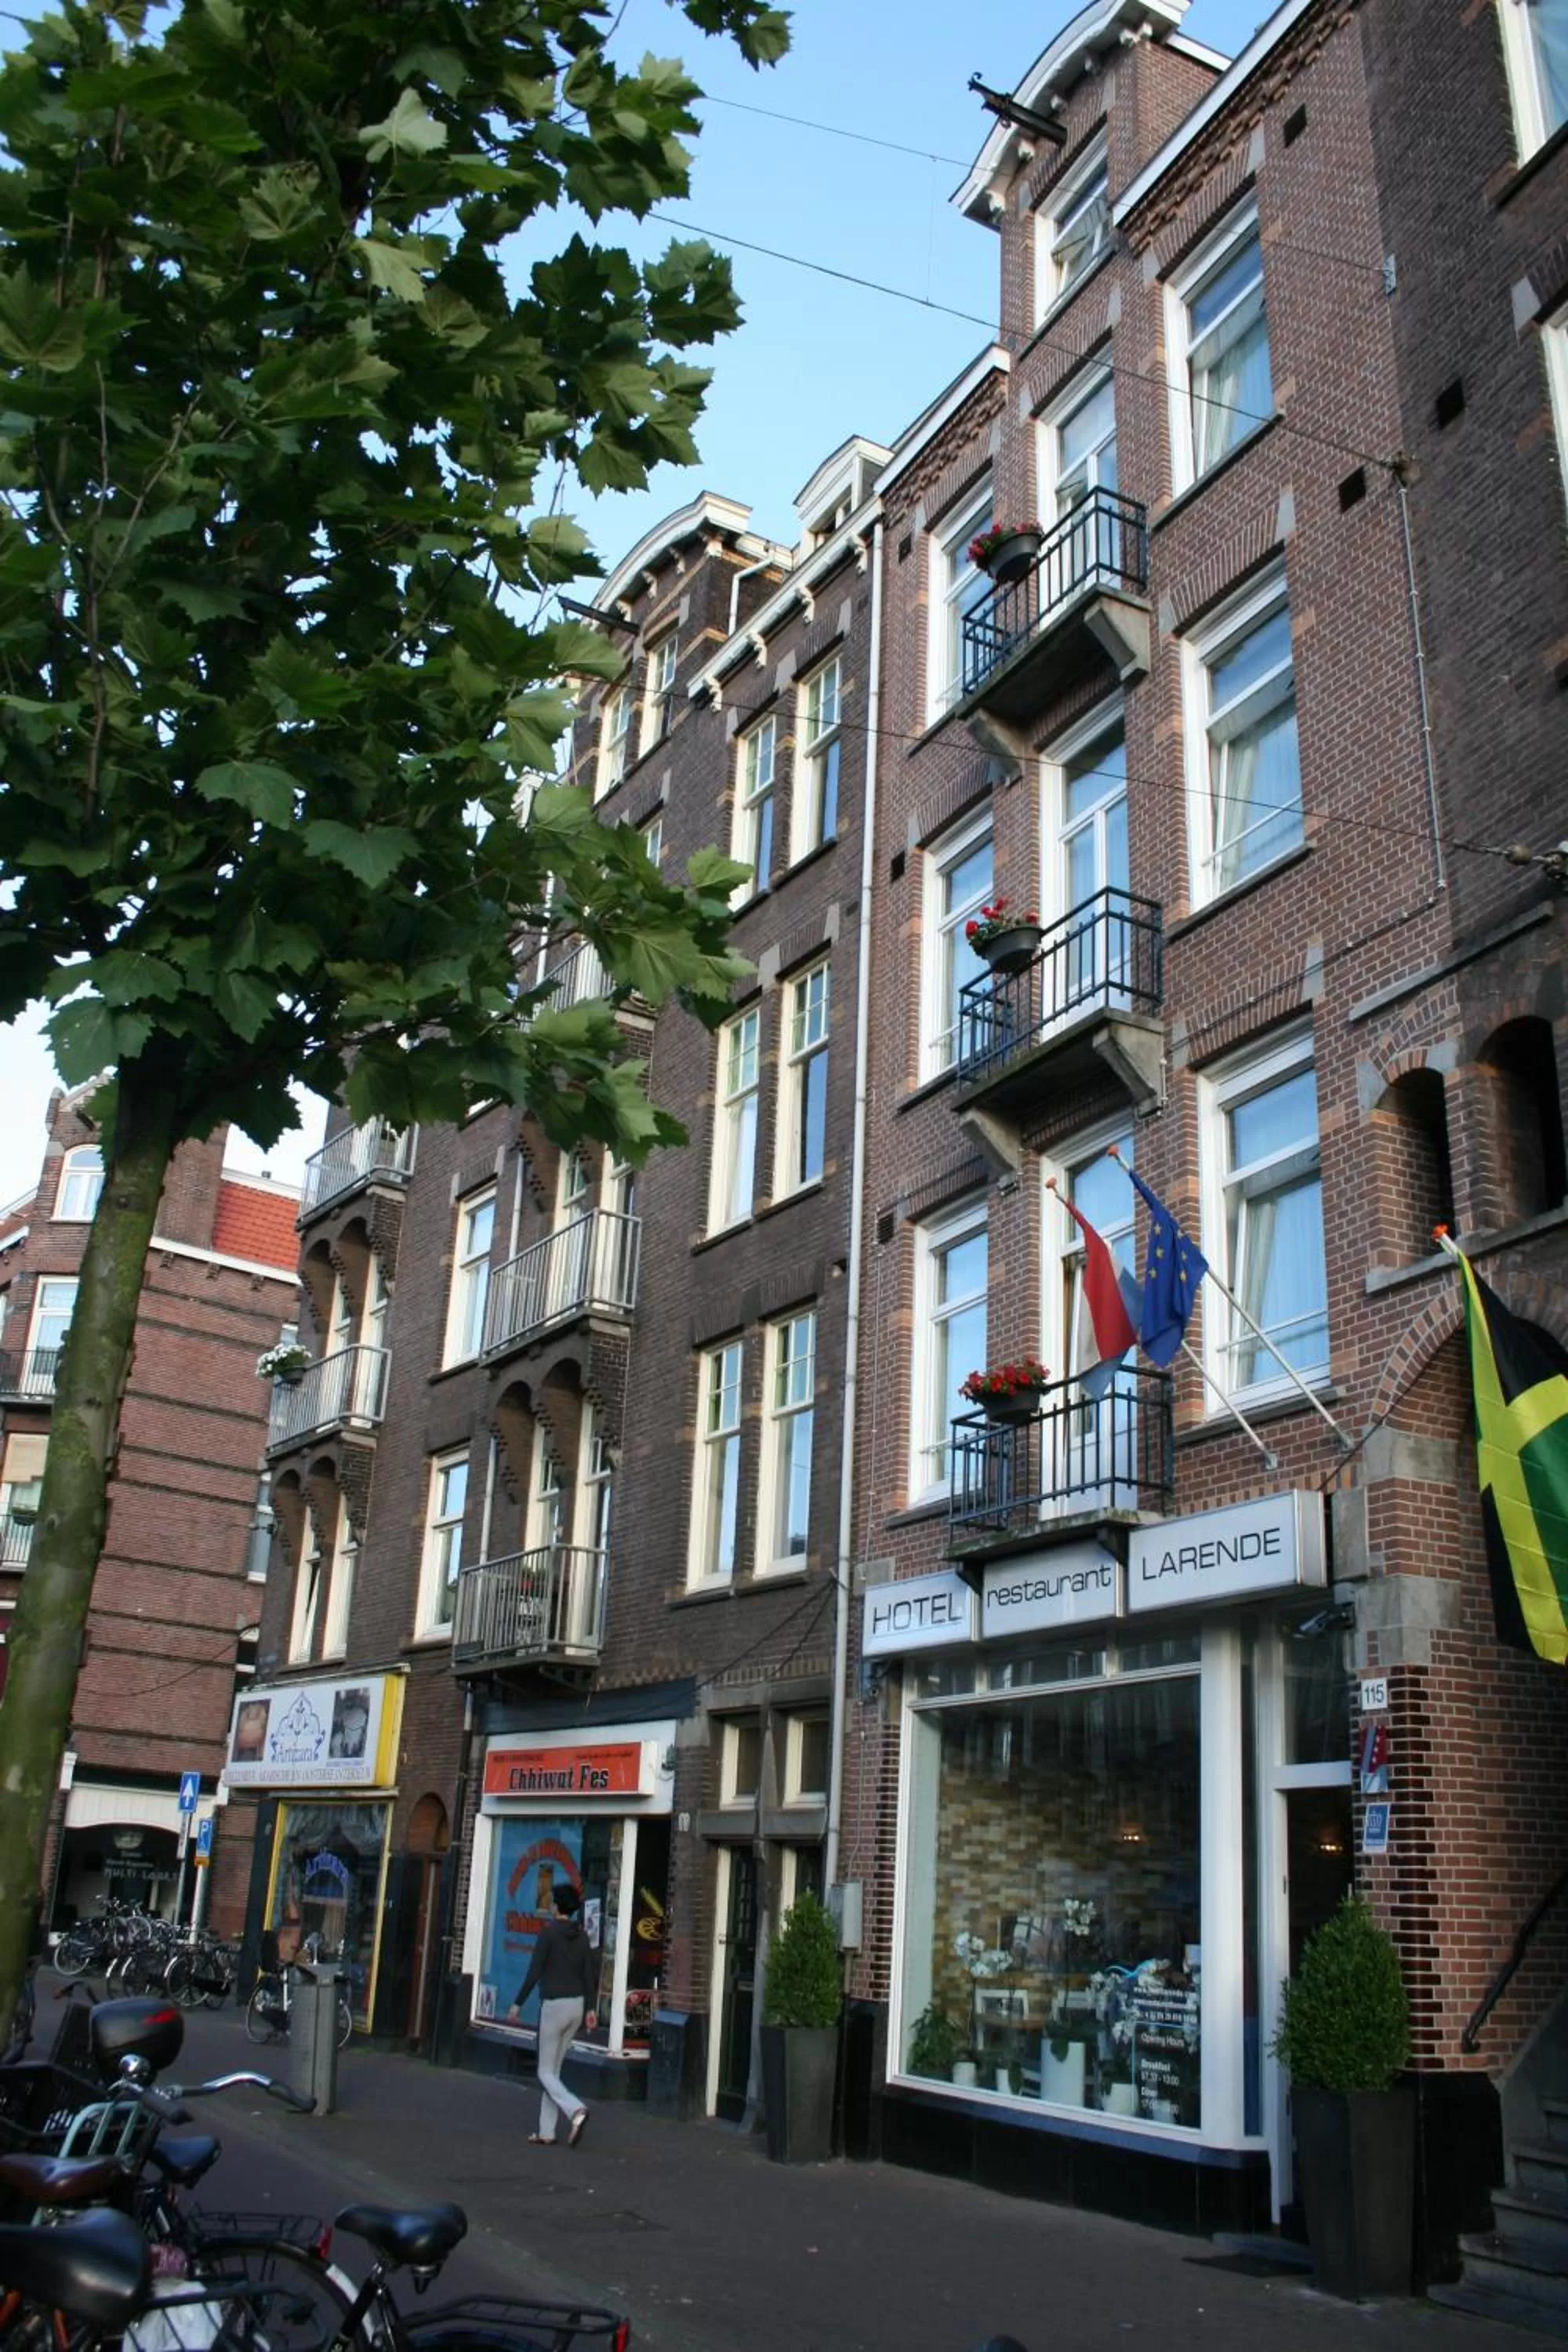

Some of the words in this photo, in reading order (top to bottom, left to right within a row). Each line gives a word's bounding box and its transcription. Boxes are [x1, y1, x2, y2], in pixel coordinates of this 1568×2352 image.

[872, 1592, 963, 1635] HOTEL
[986, 1563, 1112, 1609] restaurant
[1141, 1526, 1281, 1582] LARENDE
[1364, 1683, 1385, 1704] 115
[510, 1765, 573, 1790] Chhiwat
[579, 1763, 609, 1789] Fes
